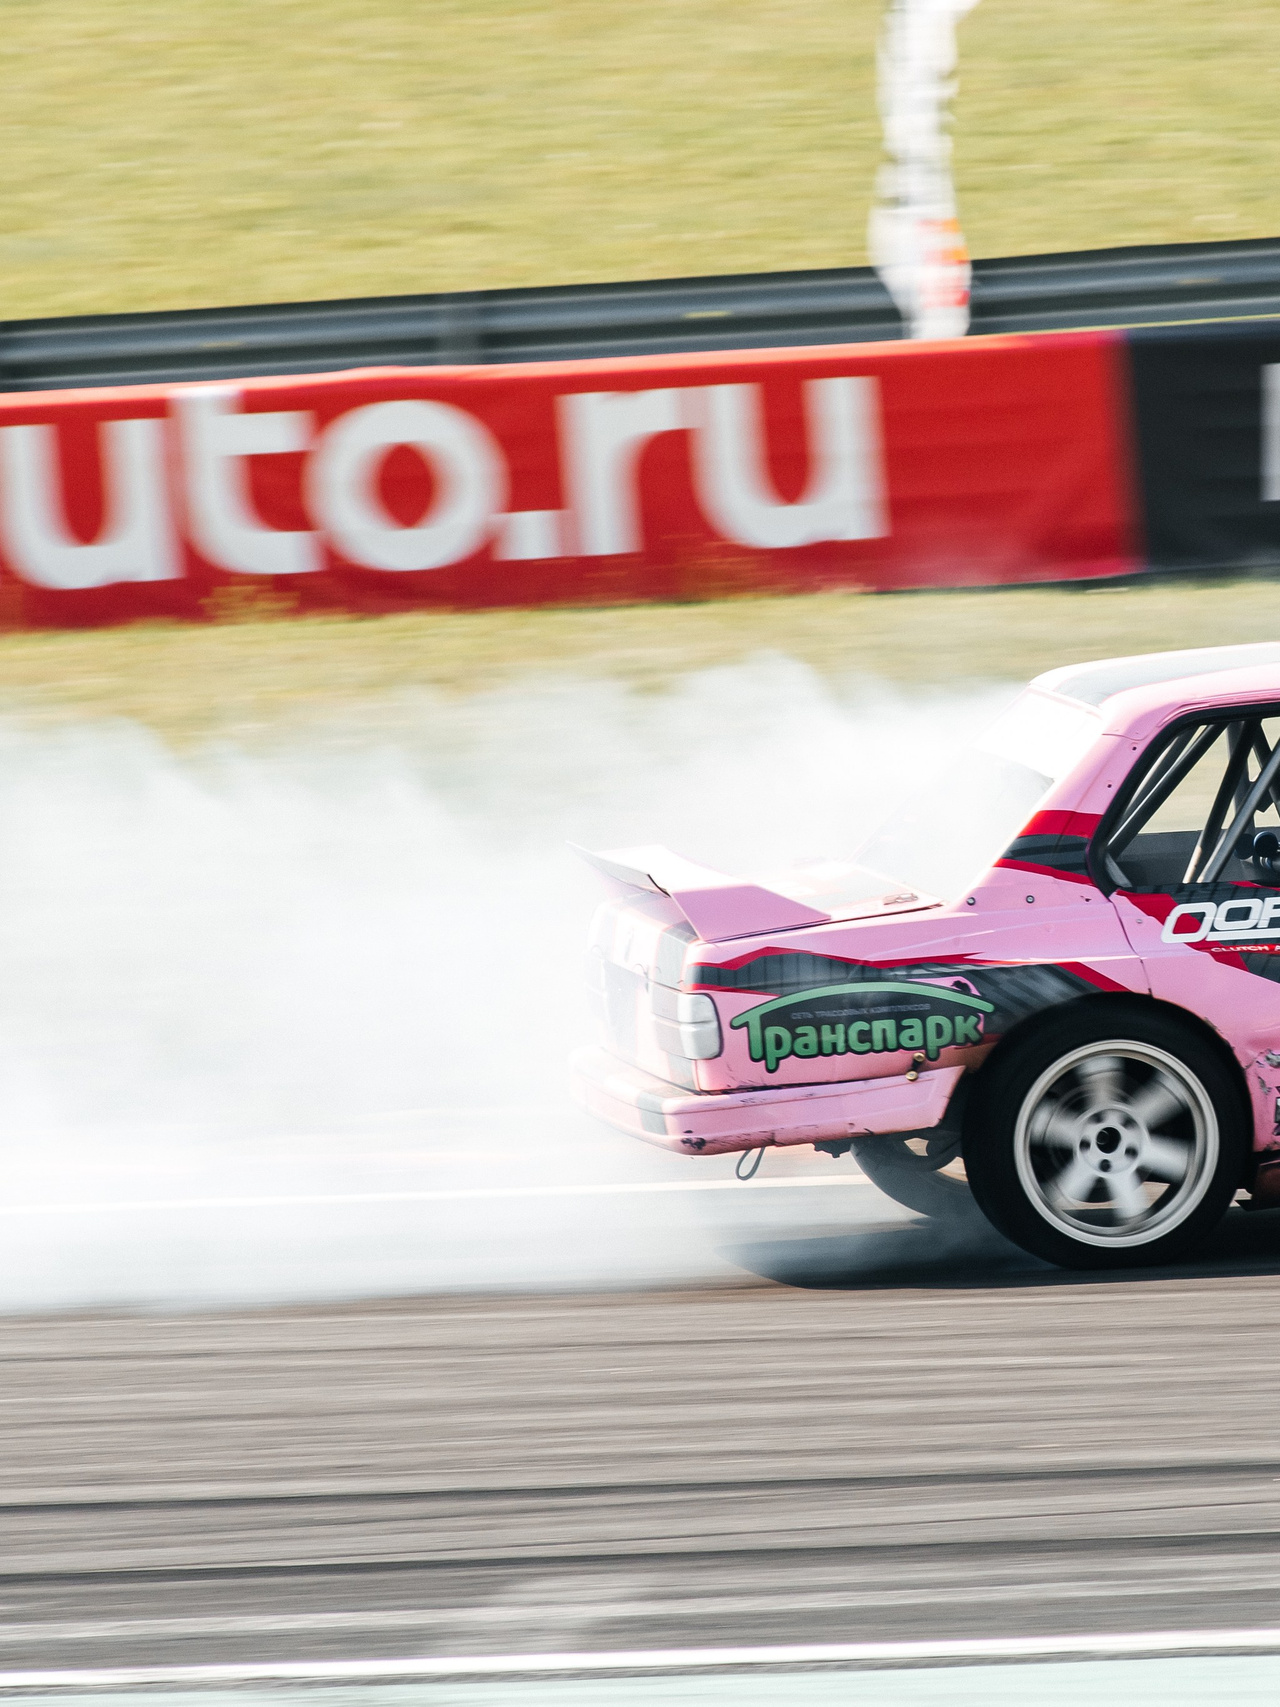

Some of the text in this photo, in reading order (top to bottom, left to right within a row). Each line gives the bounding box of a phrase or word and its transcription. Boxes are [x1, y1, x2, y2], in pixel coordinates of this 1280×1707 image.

[0, 376, 889, 590] uto.ru
[1210, 944, 1269, 953] CLUTCH
[730, 981, 995, 1071] Транспарк
